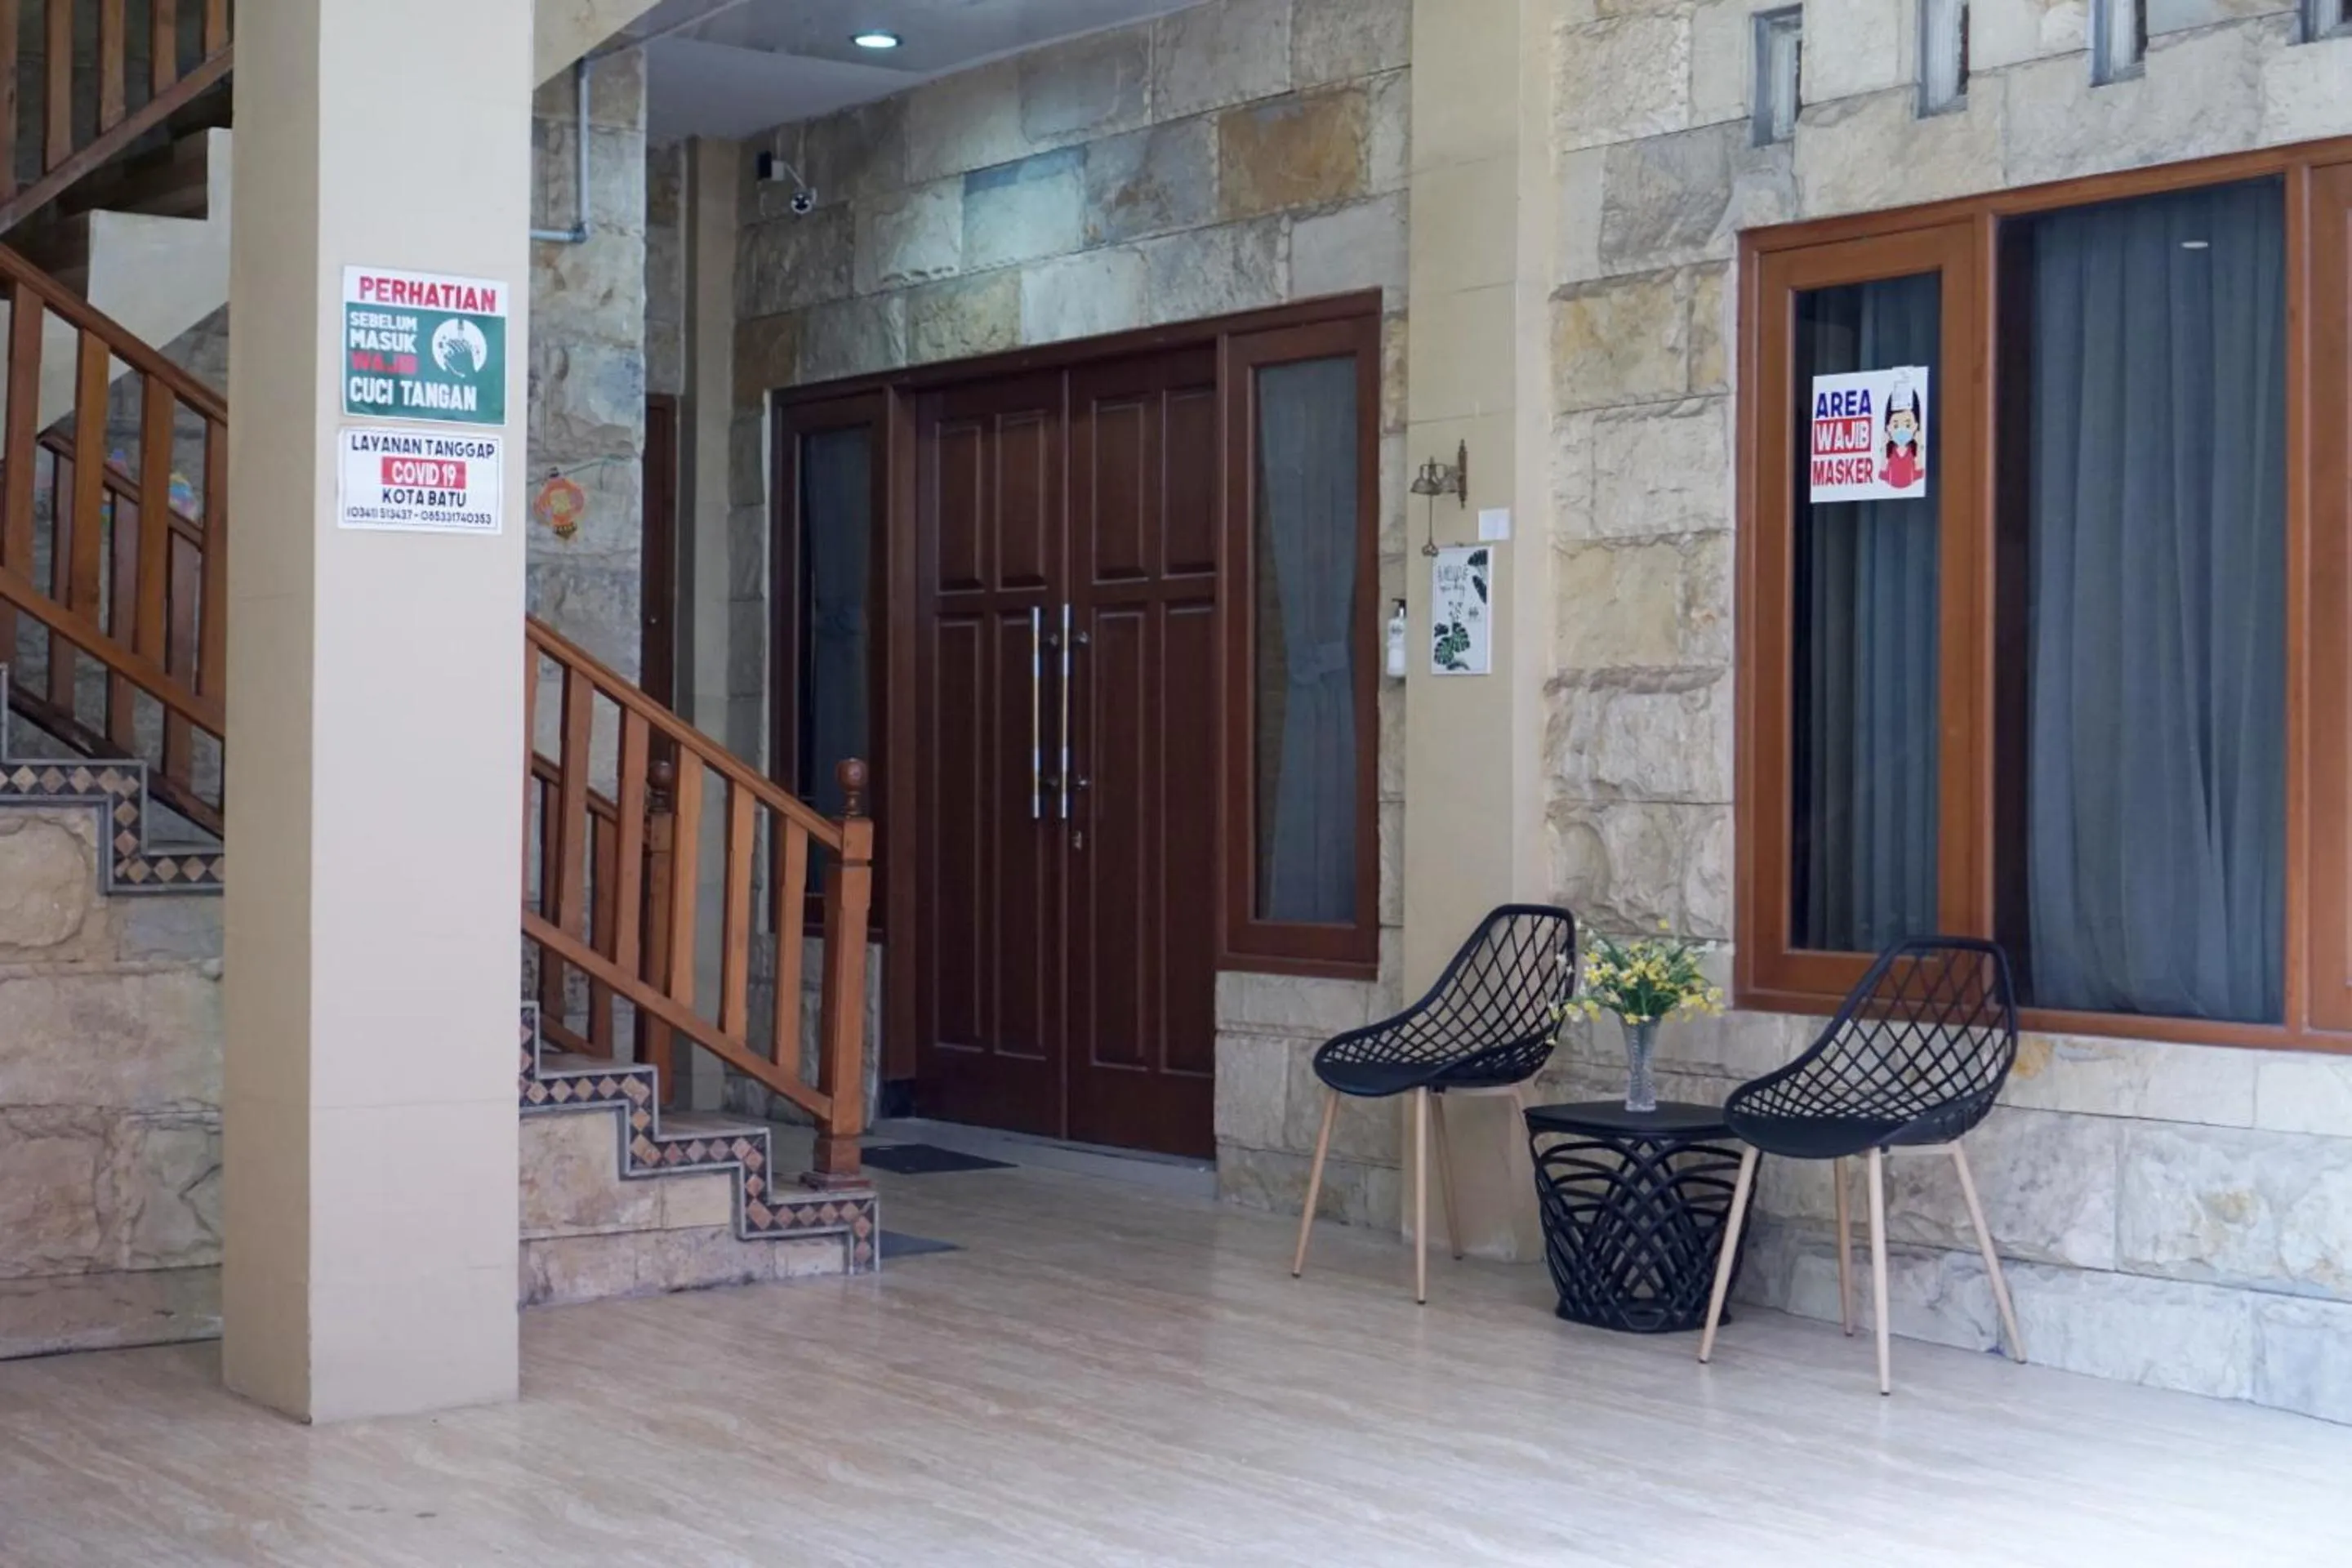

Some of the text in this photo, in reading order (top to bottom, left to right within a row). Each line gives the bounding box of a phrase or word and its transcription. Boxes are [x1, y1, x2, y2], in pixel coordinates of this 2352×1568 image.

[359, 275, 497, 313] PERHATIAN
[350, 311, 418, 332] SEBELUM
[350, 327, 417, 354] MASUK
[350, 376, 477, 412] CUCI TANGAN
[1815, 389, 1872, 419] AREA
[351, 434, 495, 459] LAYANAN TANGGAP
[1815, 421, 1870, 452] WAJIB
[391, 460, 457, 488] COVID 19
[1812, 457, 1874, 486] MASKER
[381, 488, 467, 508] KOTA BATU
